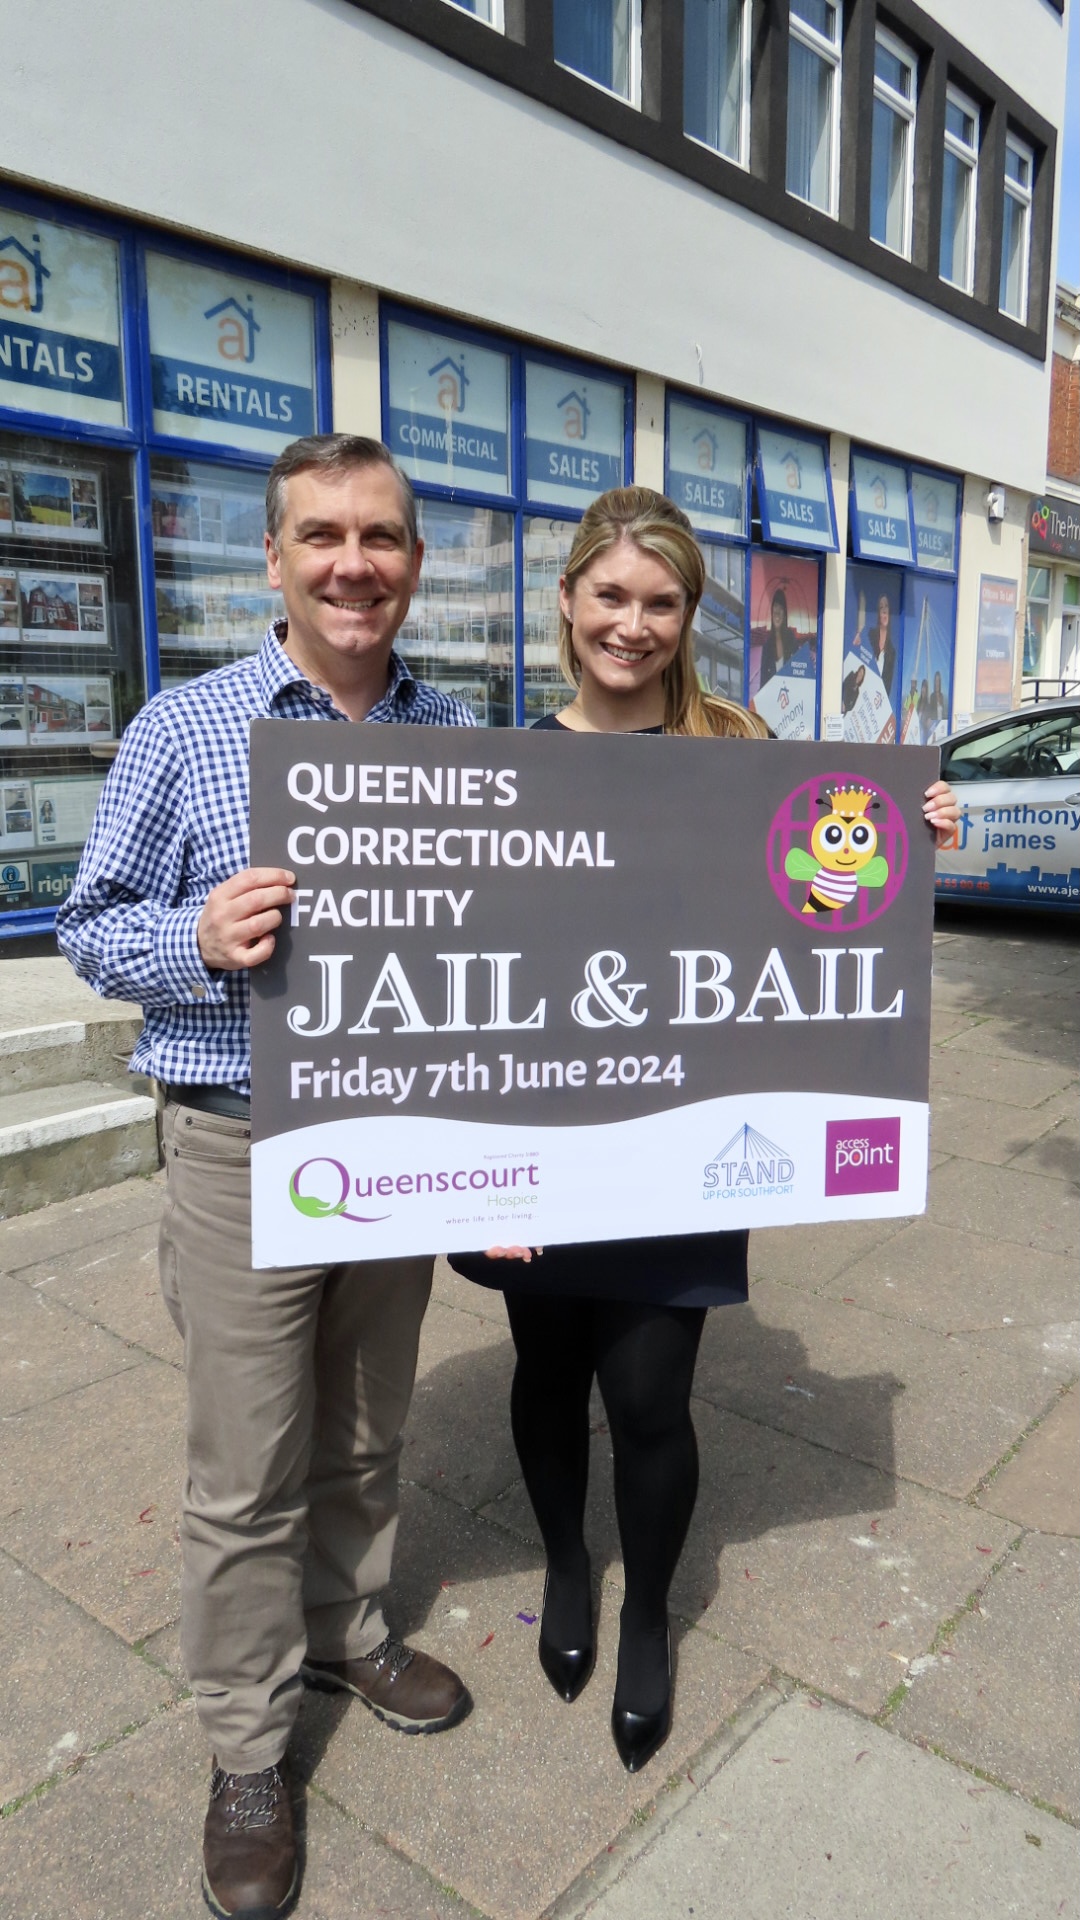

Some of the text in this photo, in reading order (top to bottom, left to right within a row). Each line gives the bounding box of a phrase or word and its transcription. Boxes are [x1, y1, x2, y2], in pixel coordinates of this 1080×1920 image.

[176, 372, 293, 423] RENTALS
[399, 424, 498, 462] COMMERCIAL
[549, 452, 600, 484] SALES
[684, 481, 725, 509] SALES
[779, 499, 814, 524] SALES
[1050, 510, 1066, 538] The
[867, 519, 897, 540] SALES
[918, 531, 942, 551] SALES
[773, 700, 804, 737] anthony
[784, 721, 806, 740] mes
[287, 762, 518, 813] QUEENIE'S
[983, 804, 1080, 831] anthony
[287, 826, 615, 867] CORRECTIONAL
[982, 828, 1056, 852] james
[1027, 885, 1080, 898] www.aje
[290, 889, 473, 927] FACILITY
[286, 947, 904, 1037] JAIL & BAIL
[290, 1052, 685, 1104] Friday 7th June 2024
[835, 1138, 870, 1150] access
[835, 1143, 894, 1174] point
[703, 1158, 795, 1188] STAND
[289, 1157, 540, 1223] Queenscourt
[487, 1194, 538, 1208] Hospice
[703, 1184, 794, 1200] UP FOR SOUTHPORT
